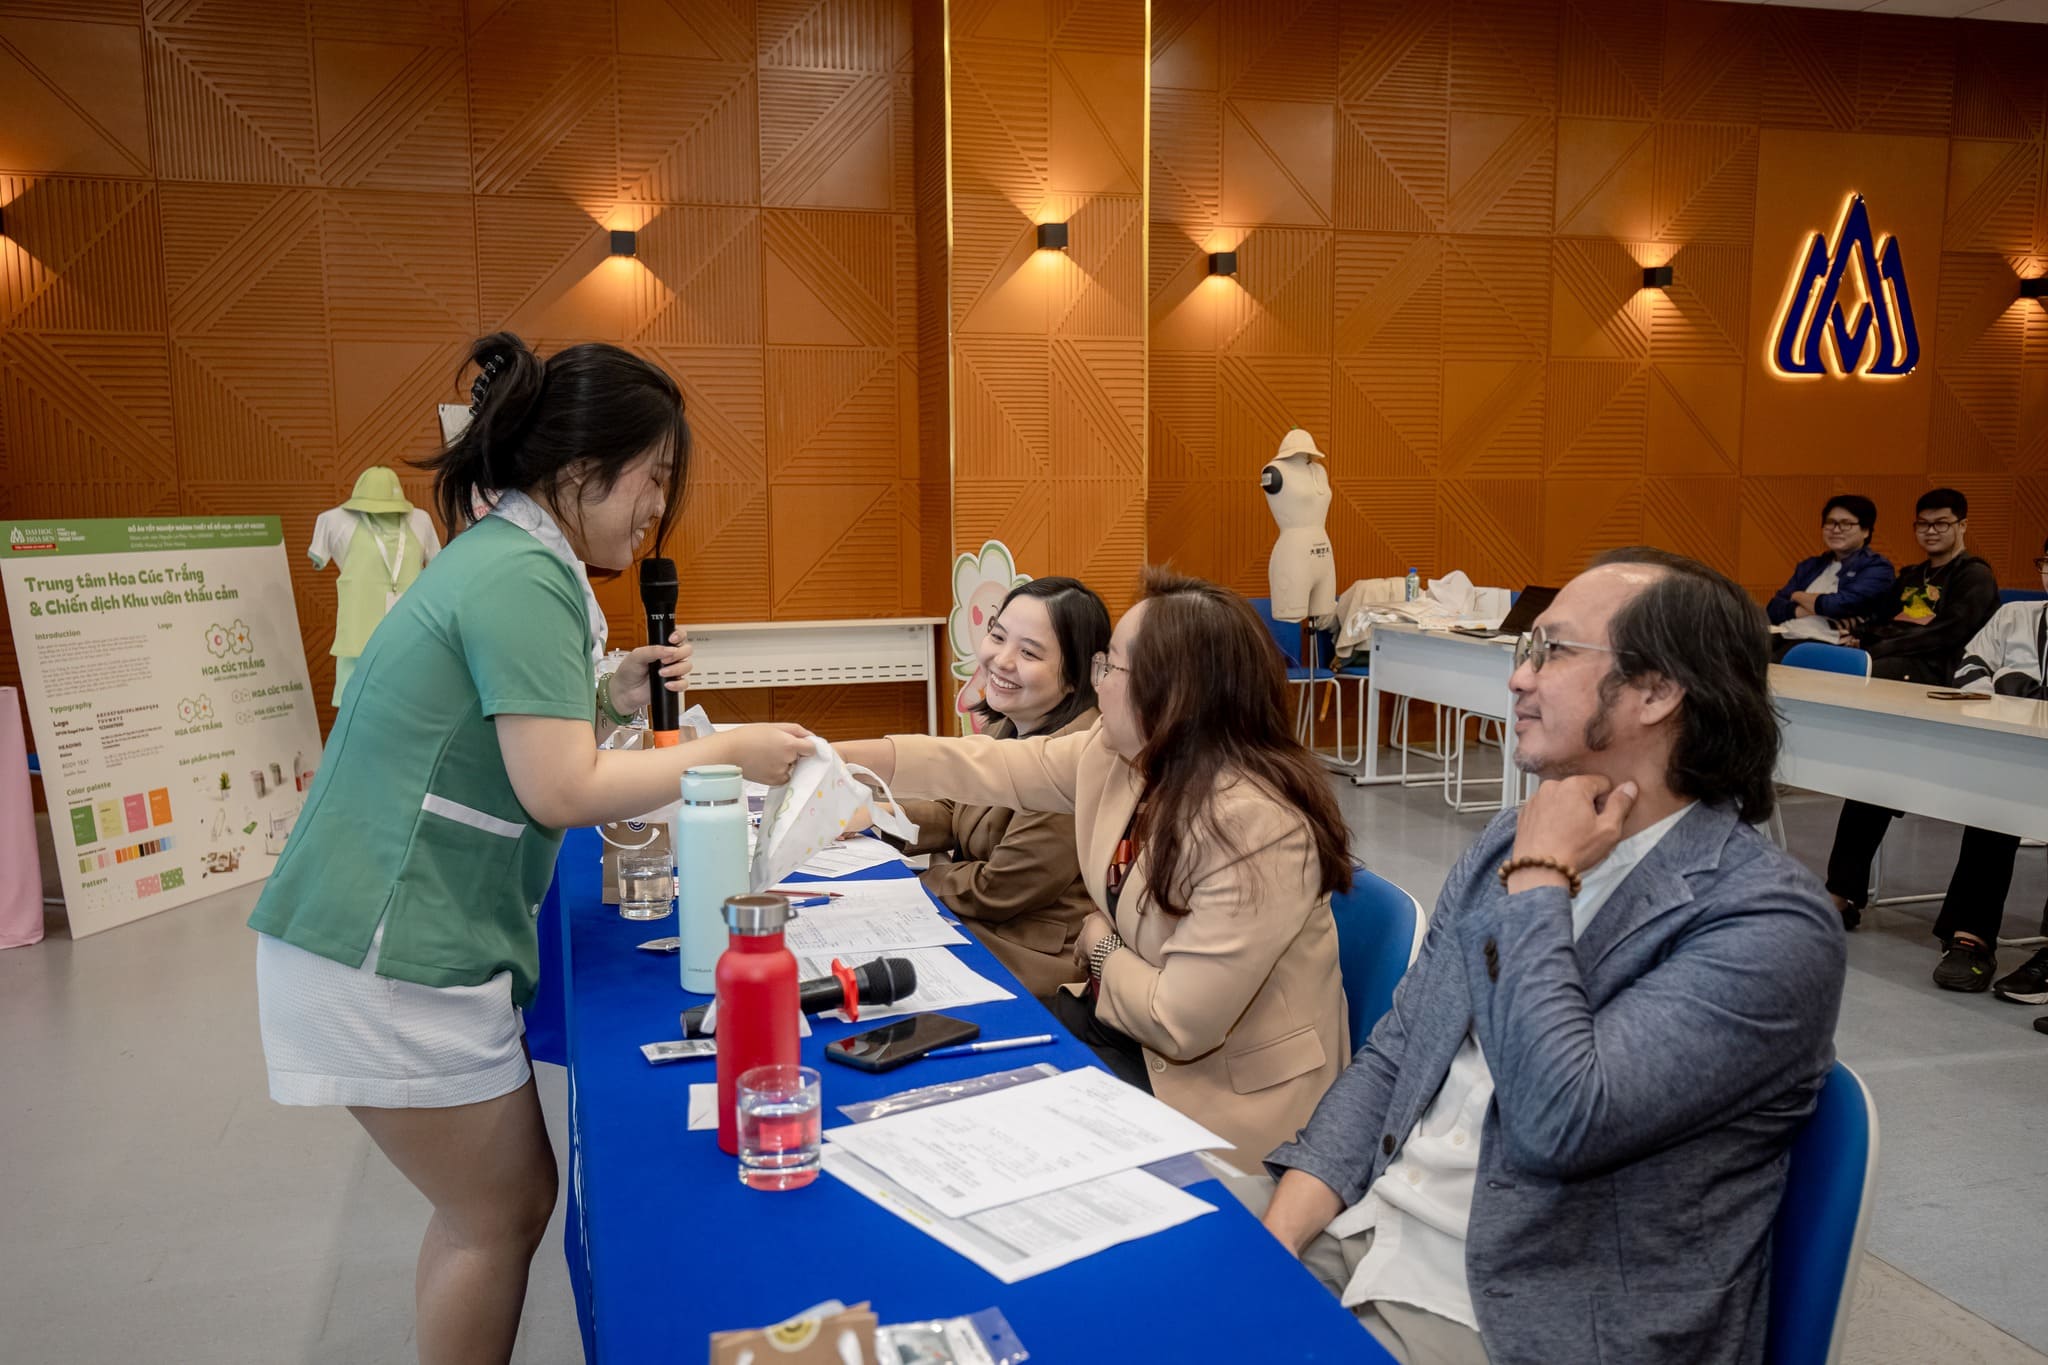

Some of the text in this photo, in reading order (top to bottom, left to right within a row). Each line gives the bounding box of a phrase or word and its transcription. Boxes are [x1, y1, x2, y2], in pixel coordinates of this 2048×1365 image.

[24, 563, 204, 593] Trung tâm Hoa Cúc Trắng
[30, 584, 238, 616] & Chiến dịch Khu vườn thấu cảm
[35, 630, 80, 640] Introduction
[202, 666, 220, 676] HOA
[221, 661, 236, 673] CÚC
[252, 689, 267, 698] HOA
[49, 702, 92, 714] Typography
[58, 742, 82, 750] HEADING
[66, 782, 111, 796] Color palette
[82, 878, 108, 888] Pattern
